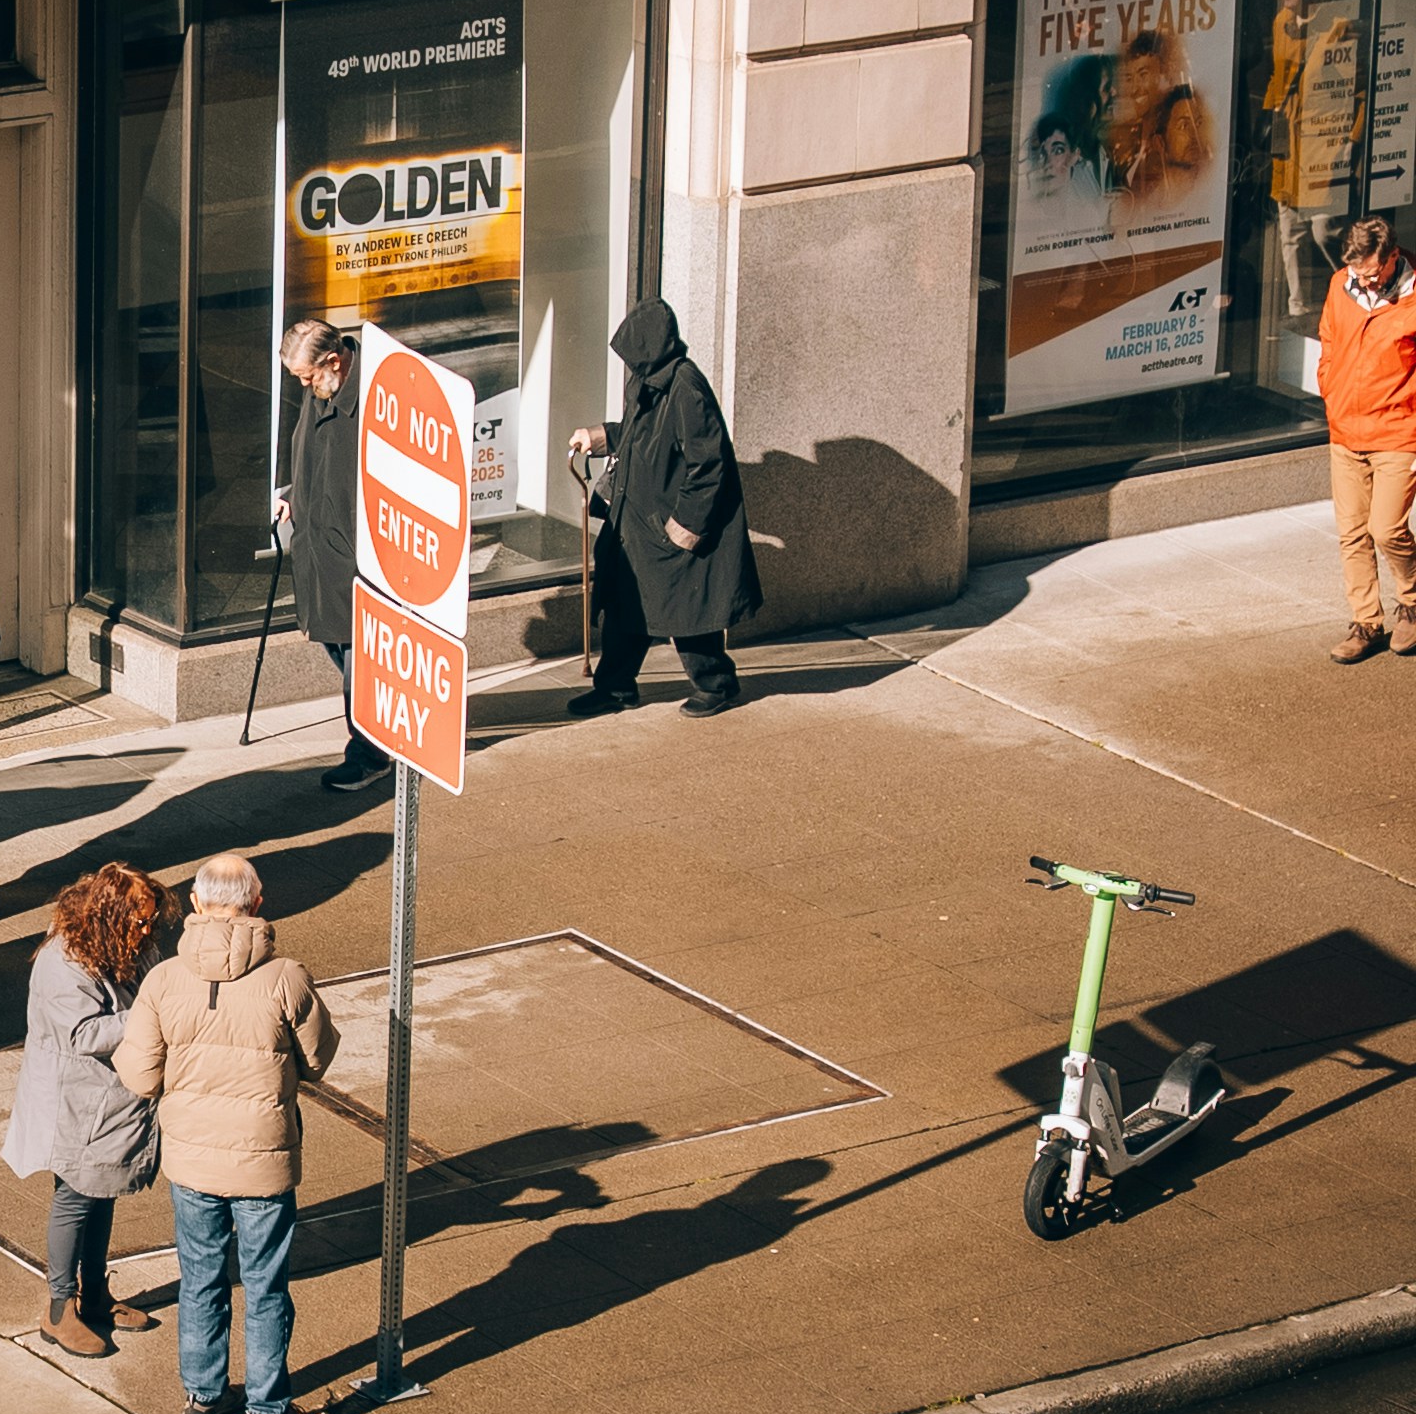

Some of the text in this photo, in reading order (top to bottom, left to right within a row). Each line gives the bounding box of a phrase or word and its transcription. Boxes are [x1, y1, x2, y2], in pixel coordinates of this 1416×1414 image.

[460, 17, 506, 39] ACT'S
[1039, 7, 1106, 57] FIVE
[328, 37, 506, 78] 49th WORLD PREMIERE
[1324, 47, 1352, 66] BOX
[1394, 68, 1411, 79] YOUR
[301, 156, 502, 231] GOLDEN
[1173, 216, 1211, 229] MITCHELL
[336, 227, 468, 256] BY ANDREW LEE CREECH
[1025, 244, 1051, 255] JASON
[1052, 237, 1083, 250] ROBERT
[335, 244, 468, 271] DIRECTED BY TYRONE PHILLIPS
[1168, 287, 1208, 312] ACT
[1122, 316, 1185, 341] FEBRUARY
[1189, 314, 1196, 328] 8
[1106, 331, 1204, 361] MARCH 16, 2025
[1141, 355, 1203, 373] acttheatre.org
[374, 383, 453, 463] DO NOT
[478, 447, 495, 464] 26
[471, 464, 505, 483] 2025
[378, 498, 440, 571] ENTER
[361, 607, 451, 704] WRONG
[374, 677, 431, 749] WAY
